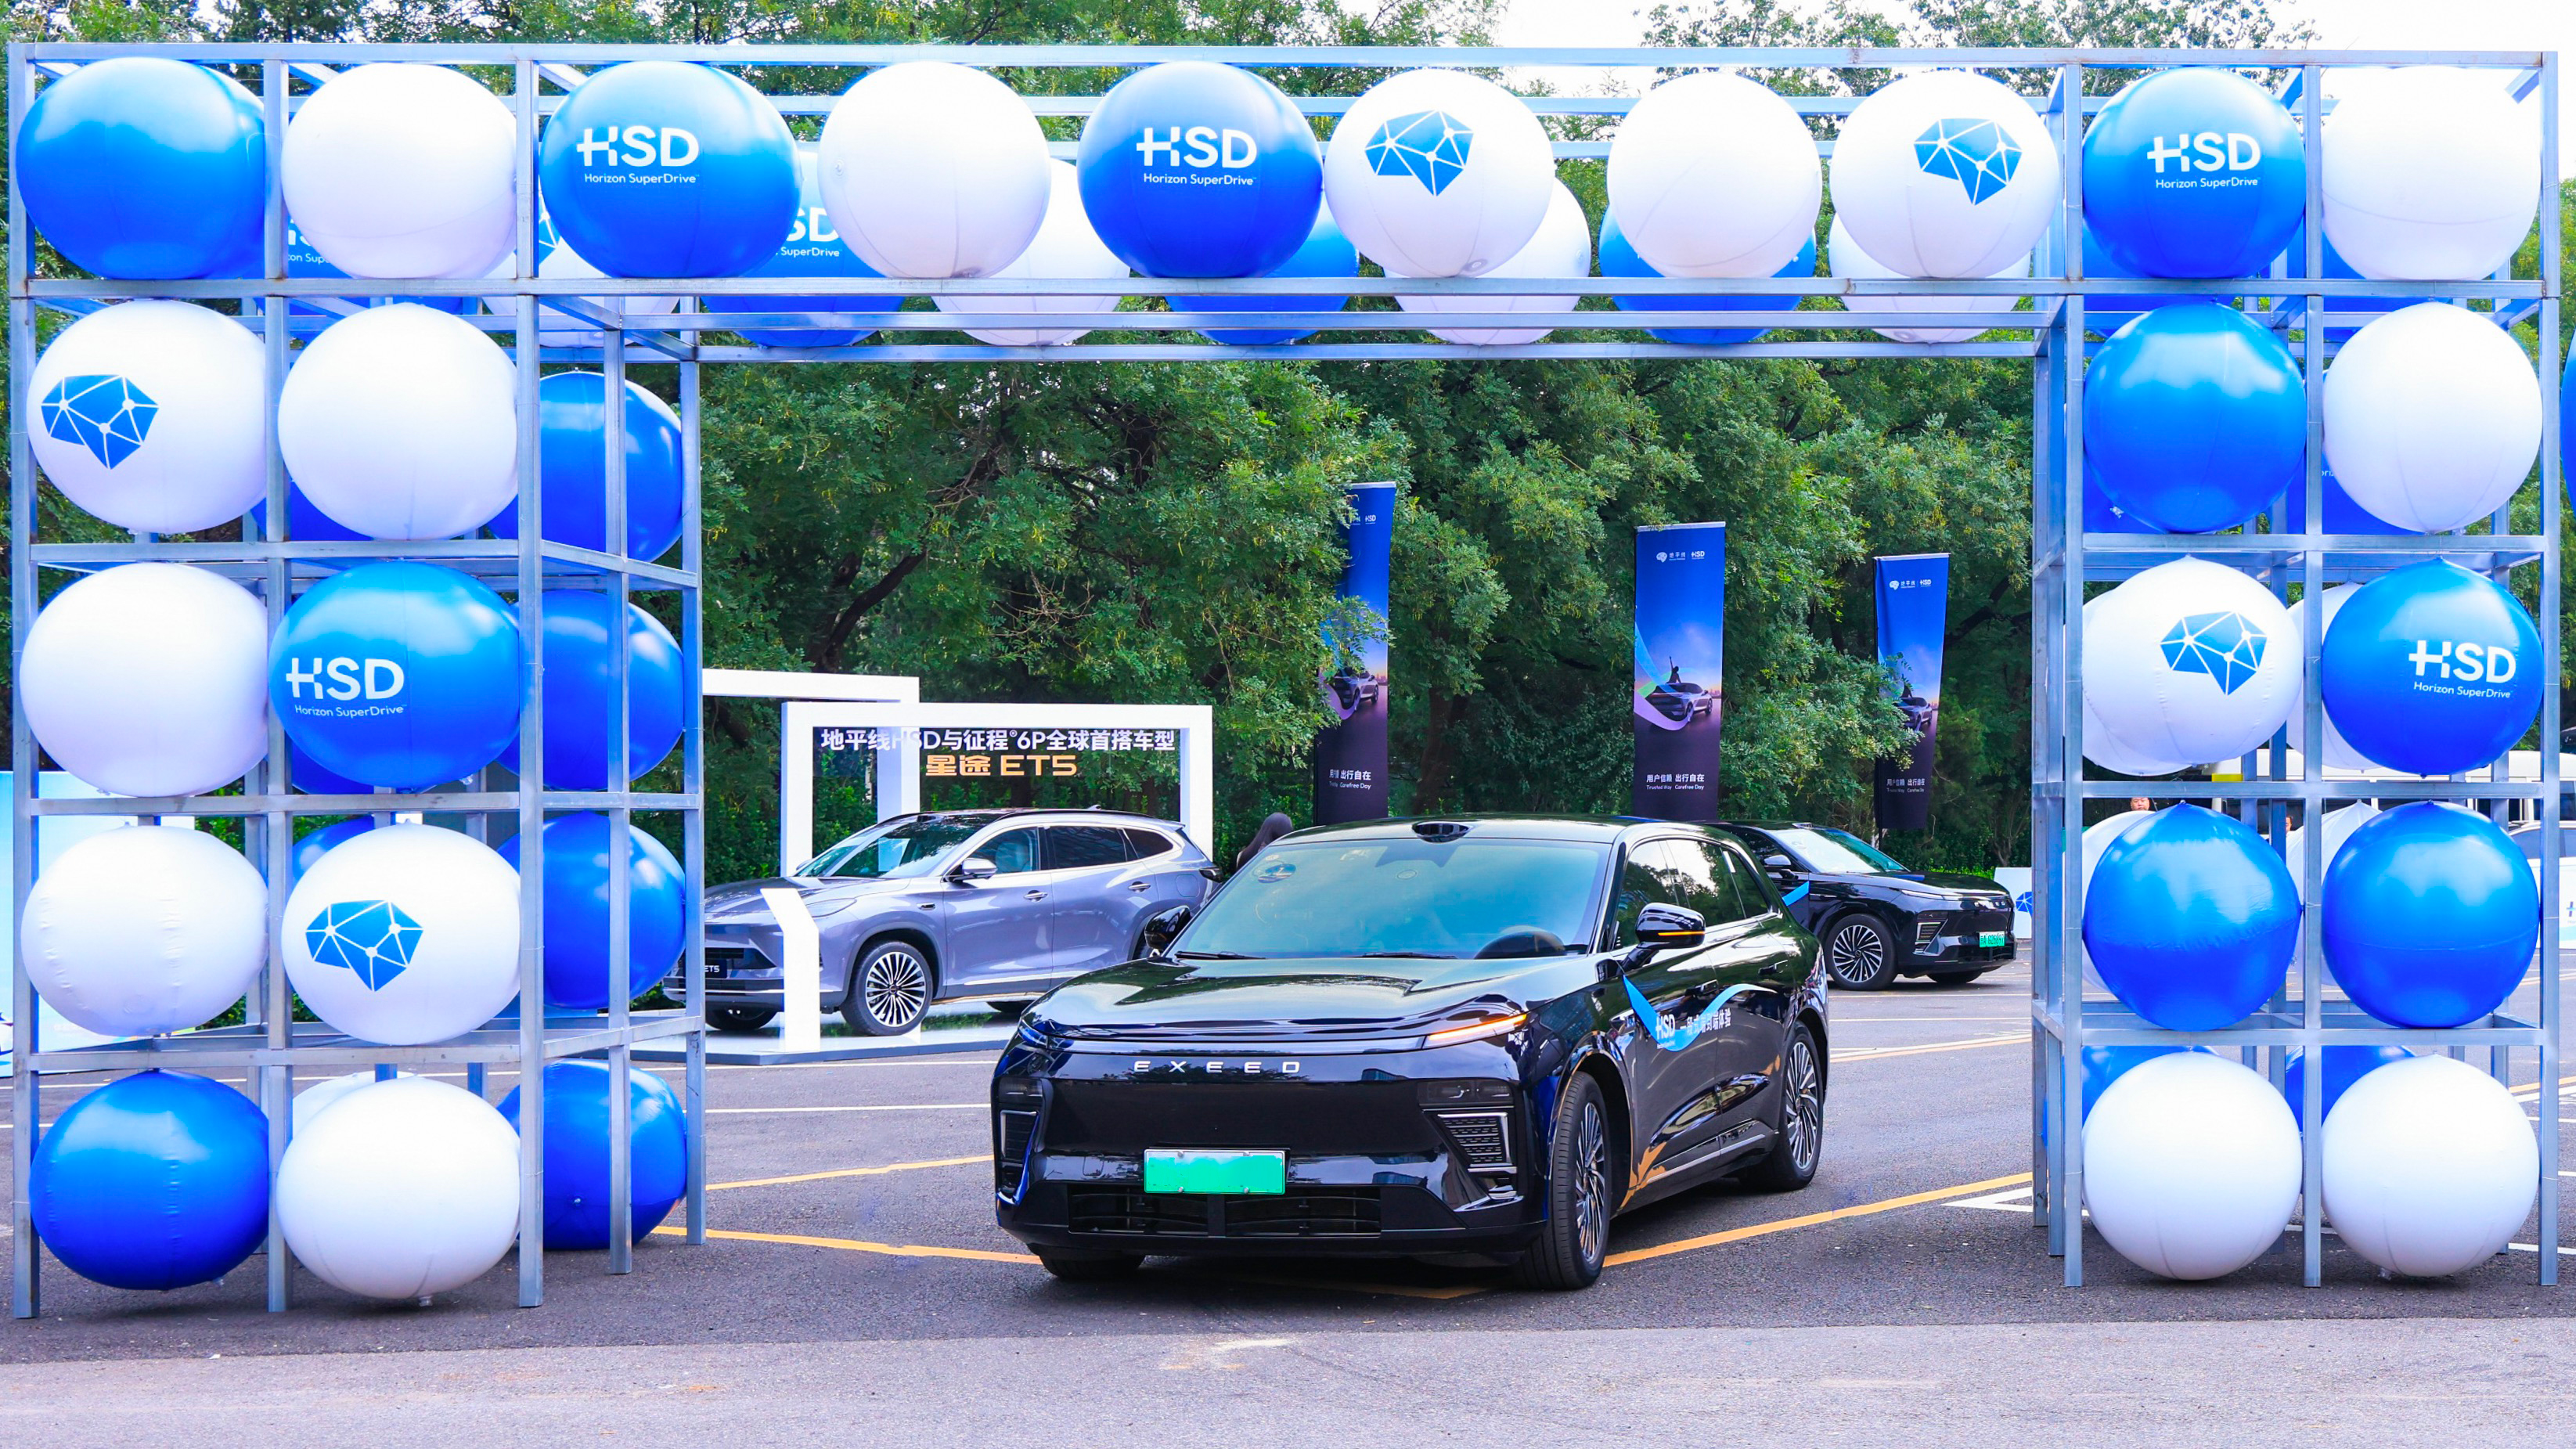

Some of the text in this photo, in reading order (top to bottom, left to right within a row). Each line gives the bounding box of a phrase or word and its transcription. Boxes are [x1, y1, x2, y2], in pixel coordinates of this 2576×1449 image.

[576, 125, 700, 167] HSD
[1136, 126, 1257, 168] HSD
[2146, 132, 2261, 173] HSD
[585, 173, 625, 183] Horizon
[1144, 173, 1187, 184] Horizon
[2156, 179, 2197, 189] Horizon
[2408, 640, 2516, 683] HSD
[286, 657, 405, 701] HSD
[2413, 682, 2455, 694] Horizon
[294, 705, 333, 716] Horizon
[925, 755, 1078, 777] 星途 ET5
[1340, 770, 1371, 780] 出行自在
[1675, 773, 1705, 782] 出行自在
[1655, 1014, 1675, 1040] HSD
[1133, 1060, 1301, 1073] EXEED
